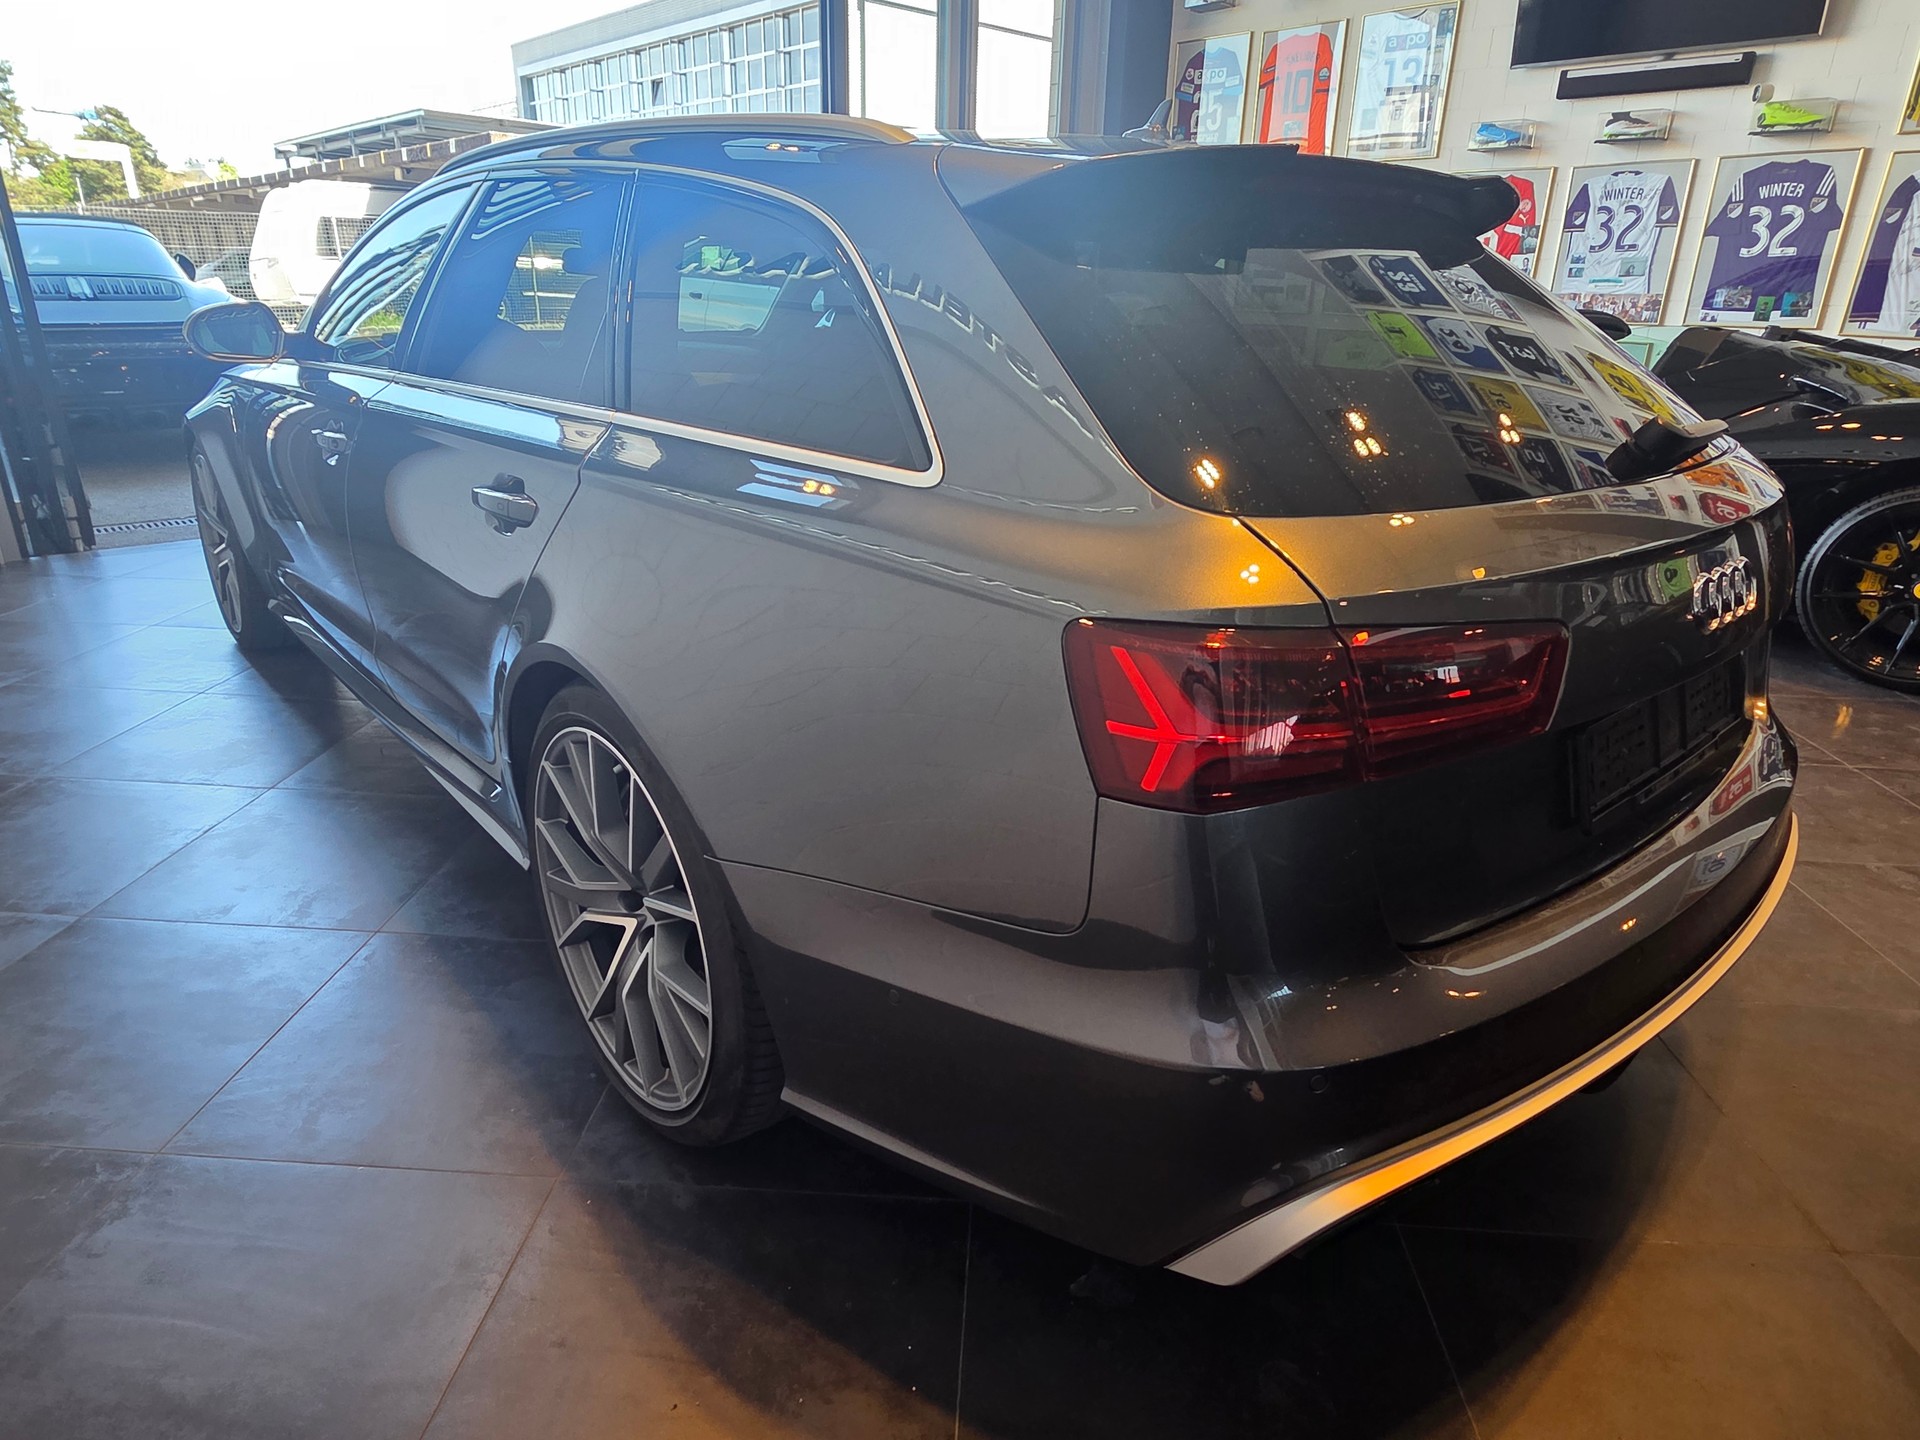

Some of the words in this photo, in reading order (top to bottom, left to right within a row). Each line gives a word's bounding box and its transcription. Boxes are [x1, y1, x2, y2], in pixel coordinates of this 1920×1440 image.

[1384, 56, 1423, 87] 13
[1283, 69, 1313, 114] 10
[1604, 187, 1645, 201] WINTER
[1759, 182, 1805, 200] WINTER
[1588, 204, 1645, 253] 32
[1739, 204, 1805, 257] 32
